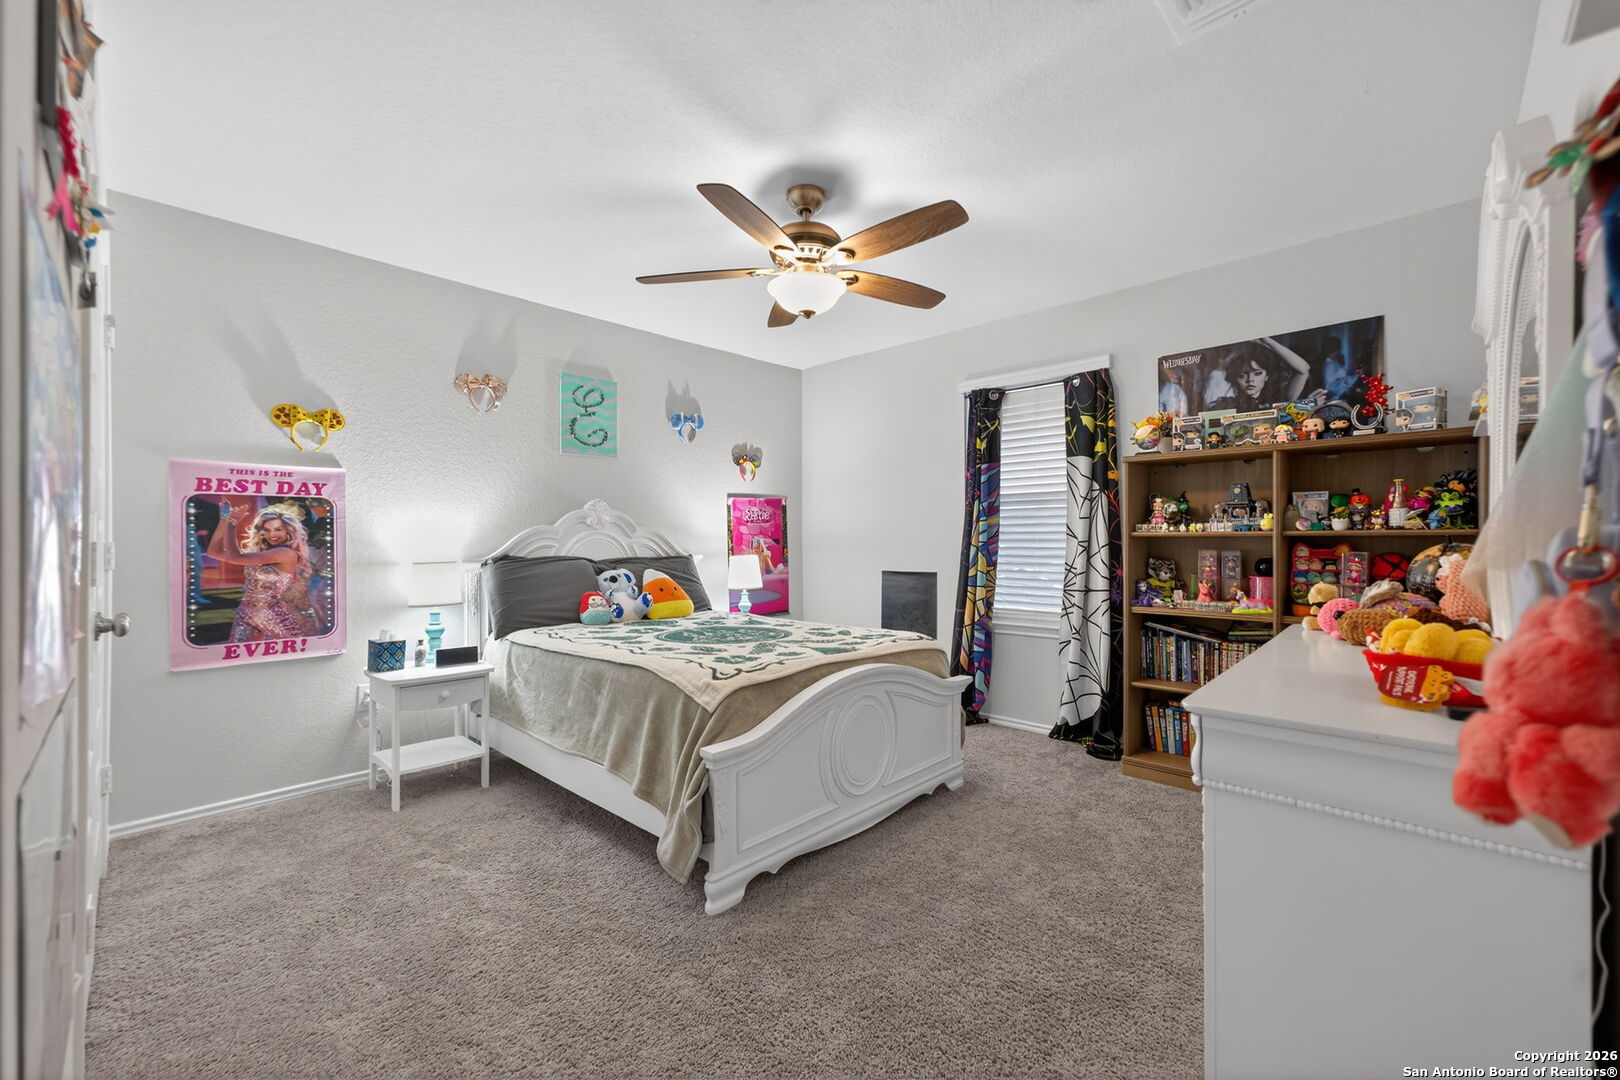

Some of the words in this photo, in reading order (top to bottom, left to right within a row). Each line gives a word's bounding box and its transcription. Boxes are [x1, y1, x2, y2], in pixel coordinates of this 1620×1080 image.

[228, 468, 255, 476] THIS
[193, 477, 268, 494] BEST
[275, 480, 328, 496] DAY
[222, 638, 308, 660] EVER!
